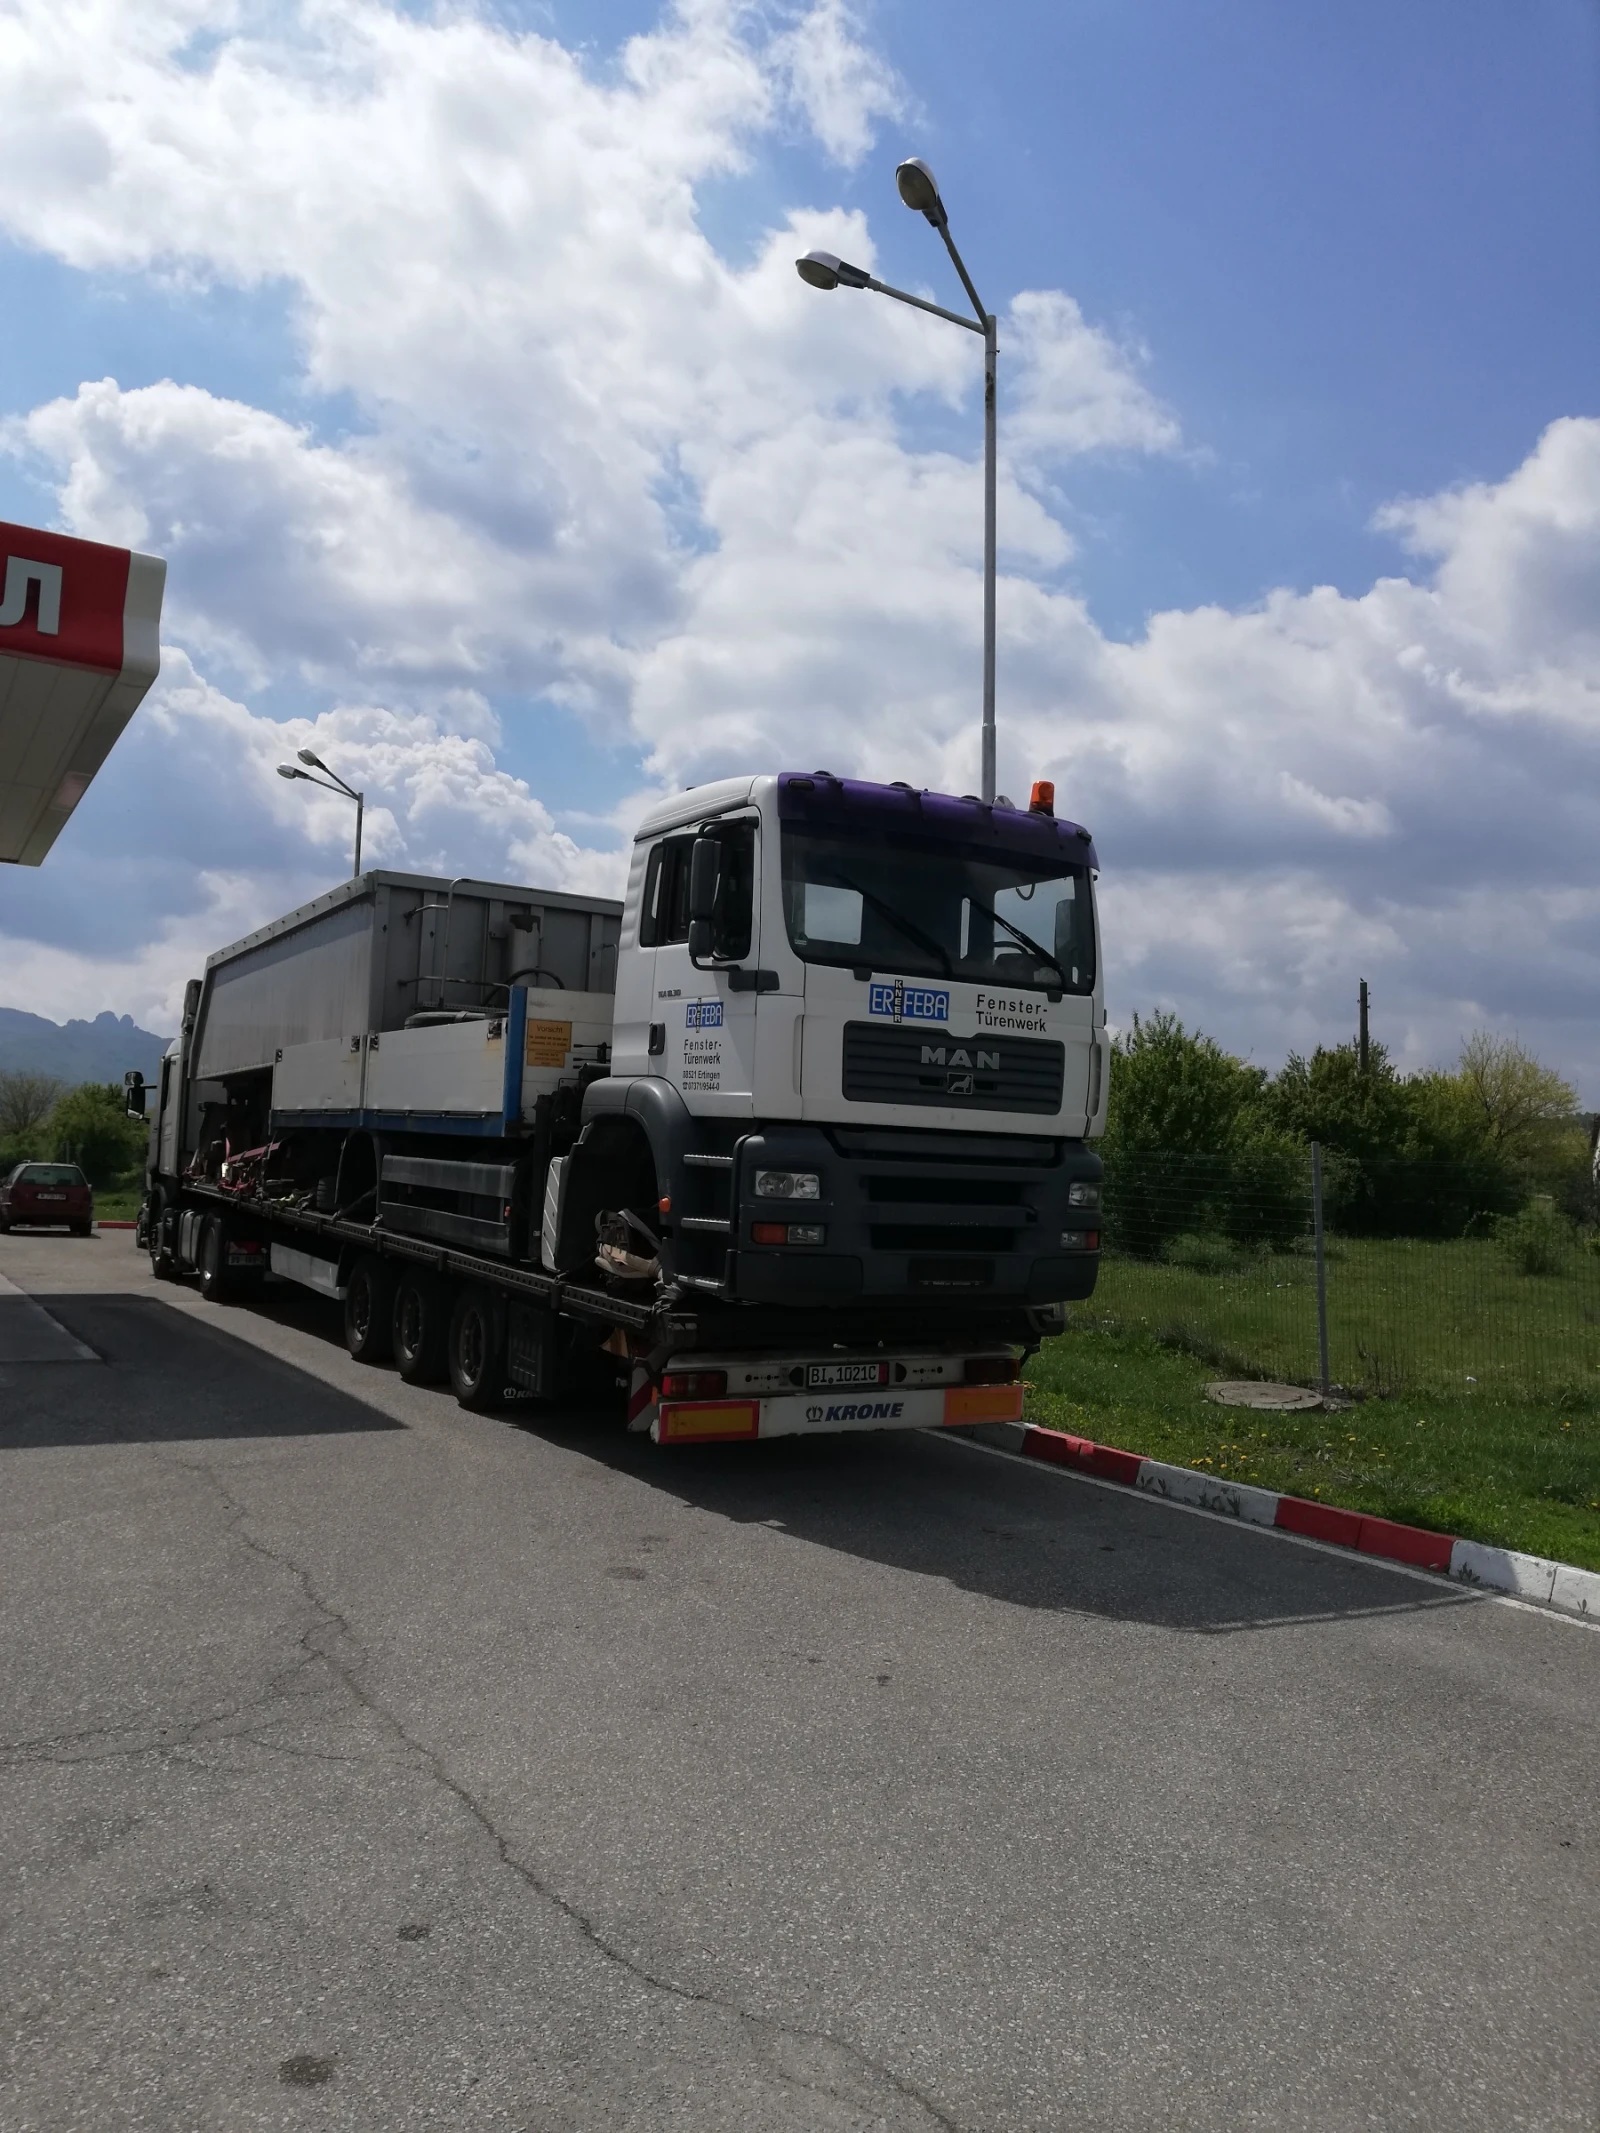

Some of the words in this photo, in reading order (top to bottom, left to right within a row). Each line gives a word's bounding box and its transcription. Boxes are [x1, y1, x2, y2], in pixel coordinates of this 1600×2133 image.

[894, 980, 903, 1022] KNEER
[976, 994, 1048, 1015] Fenster-
[976, 1011, 1047, 1032] Türenwerk
[684, 1038, 722, 1051] Fenster-
[683, 1052, 721, 1065] Türenwerk
[920, 1045, 1000, 1070] MAN
[824, 1402, 905, 1422] KRONE
